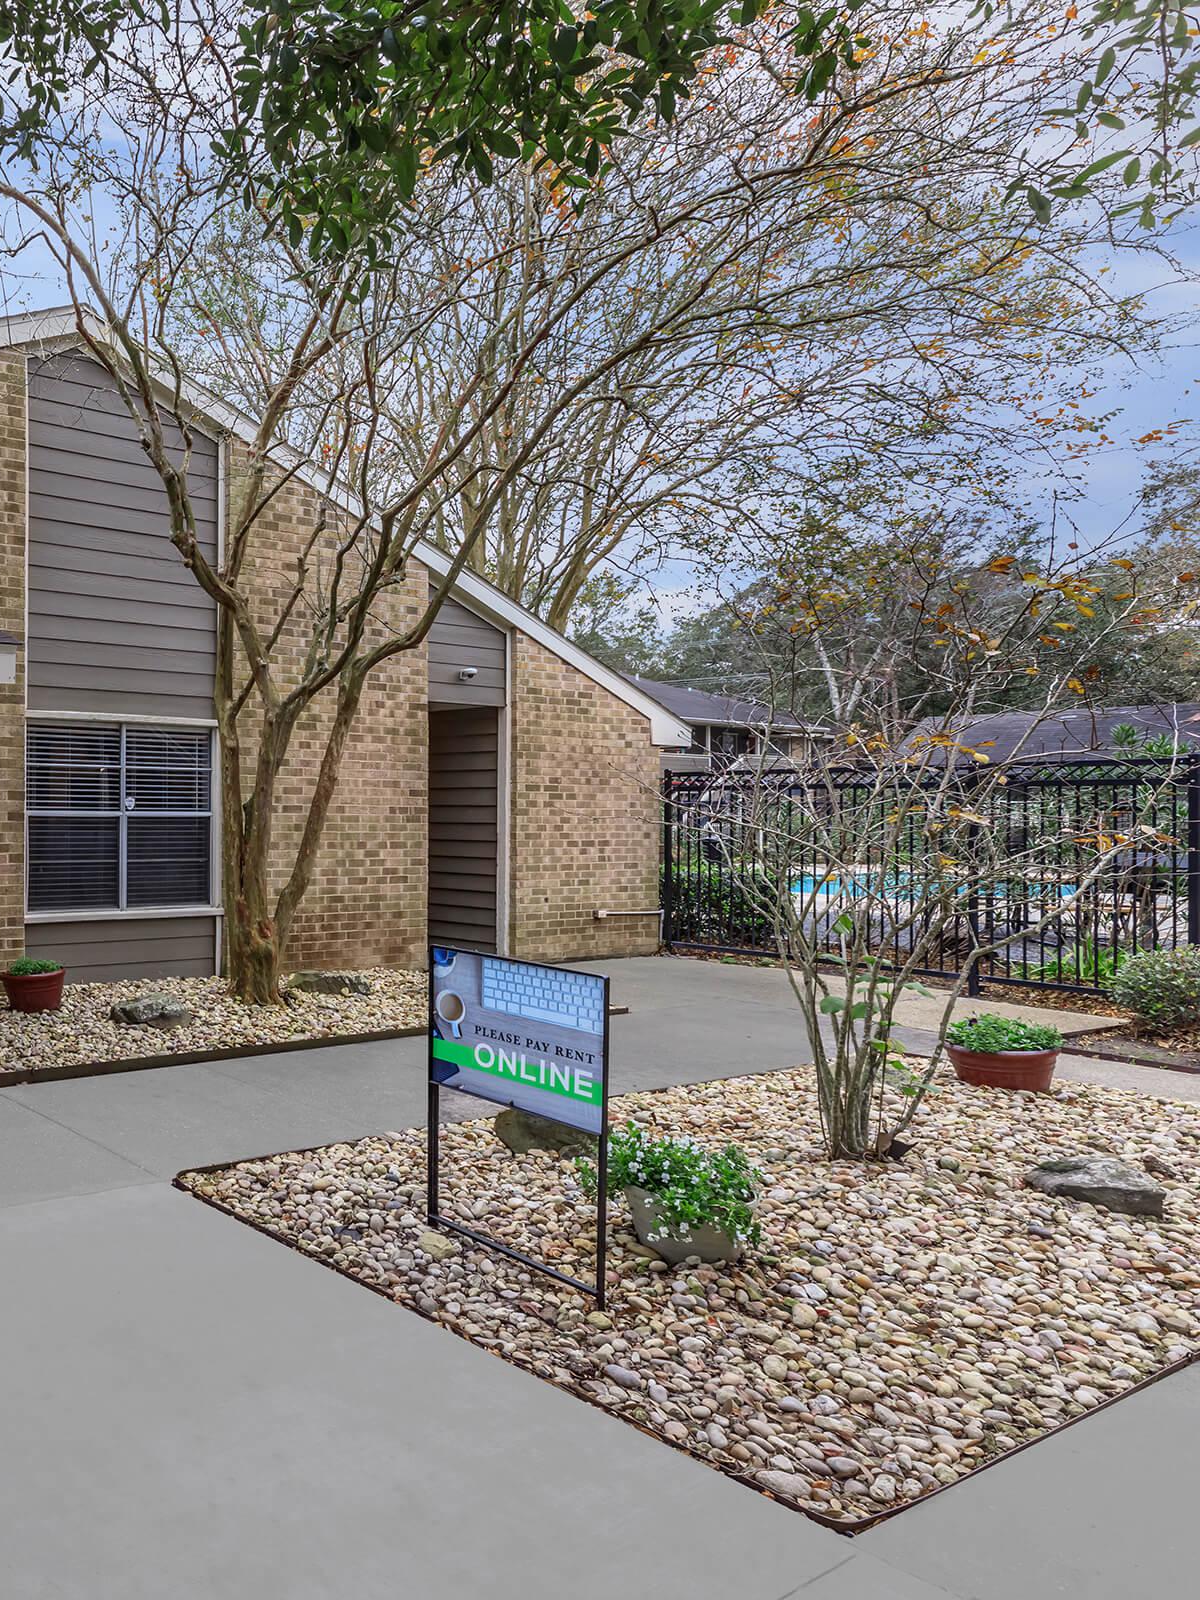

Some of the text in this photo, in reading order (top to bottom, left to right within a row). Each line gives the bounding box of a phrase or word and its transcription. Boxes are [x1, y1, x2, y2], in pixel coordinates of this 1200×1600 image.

[474, 1025, 596, 1065] PLEASE PAY RENT
[473, 1042, 593, 1098] ONLINE
